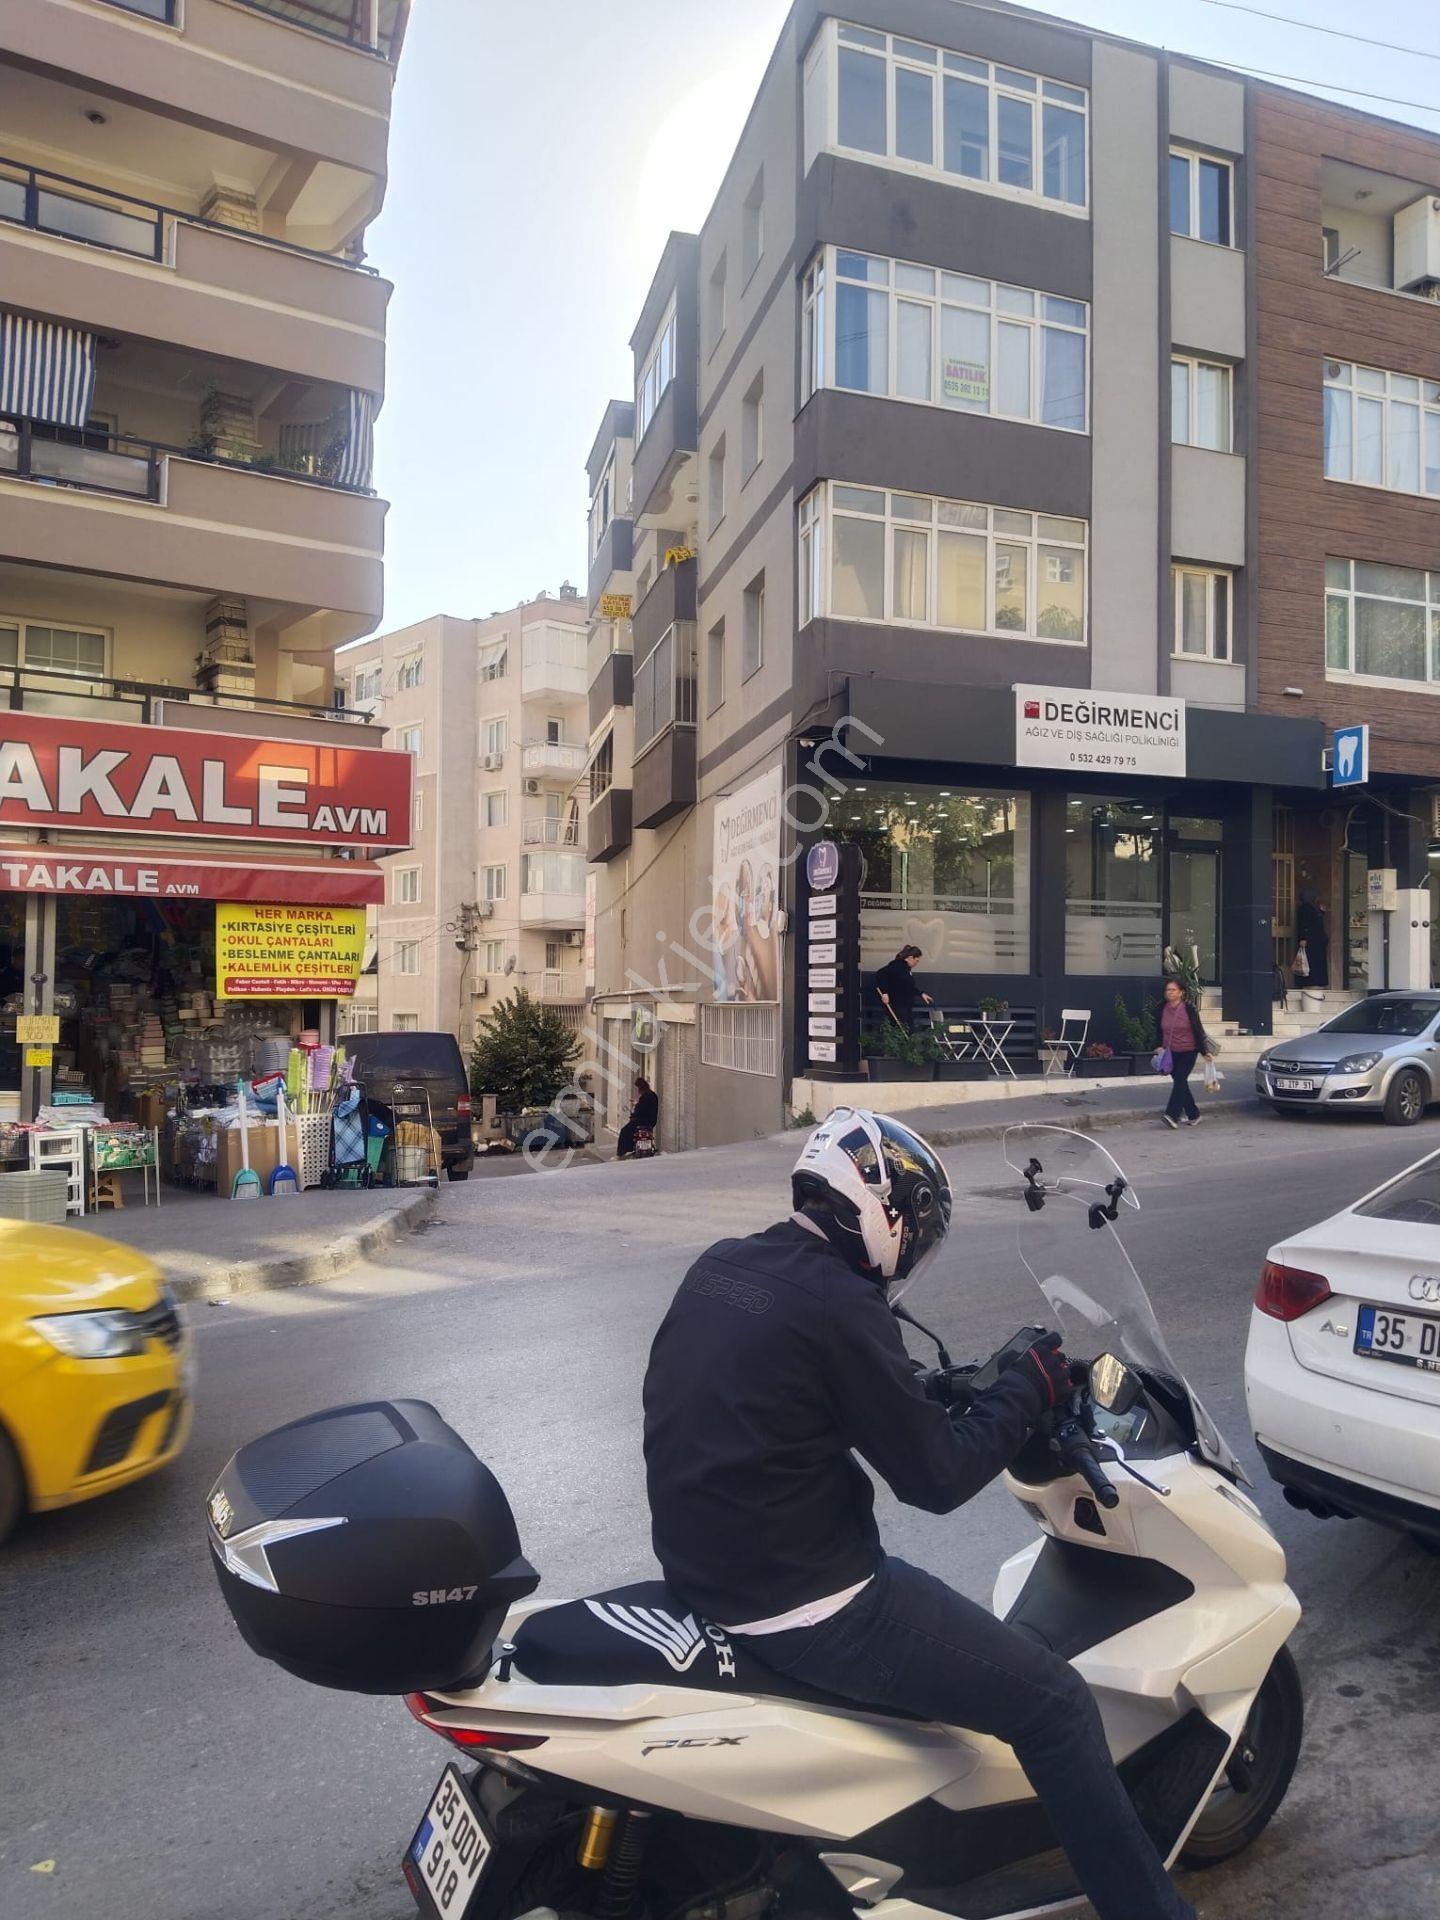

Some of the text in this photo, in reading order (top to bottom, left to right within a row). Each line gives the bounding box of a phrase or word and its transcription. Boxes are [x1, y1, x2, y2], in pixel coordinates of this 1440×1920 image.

[1045, 699, 1179, 731] DEĞİRMENCİ
[1025, 726, 1050, 737] AĞIZ
[1051, 730, 1064, 739] VE
[1085, 731, 1123, 744] SAĞLIĞI
[1070, 753, 1137, 766] 0 532 429 79 75
[311, 805, 388, 836] AVM
[2, 862, 200, 895] TAKALE AVM
[255, 909, 333, 920] HER MARKA
[227, 921, 356, 936] KIRTASİYE ÇEŞİTLERİ
[228, 936, 333, 948] OKUL ÇANTALARI
[228, 950, 360, 962] BESLENME ÇANTALARI
[228, 962, 354, 976] KALEMLİK ÇEŞİTLERİ
[1361, 1330, 1372, 1340] TR
[1375, 1315, 1406, 1350] 35
[412, 1585, 479, 1606] SH47
[641, 1736, 750, 1757] PCX
[436, 1779, 486, 1880] 35 DDV
[427, 1839, 459, 1911] 918
